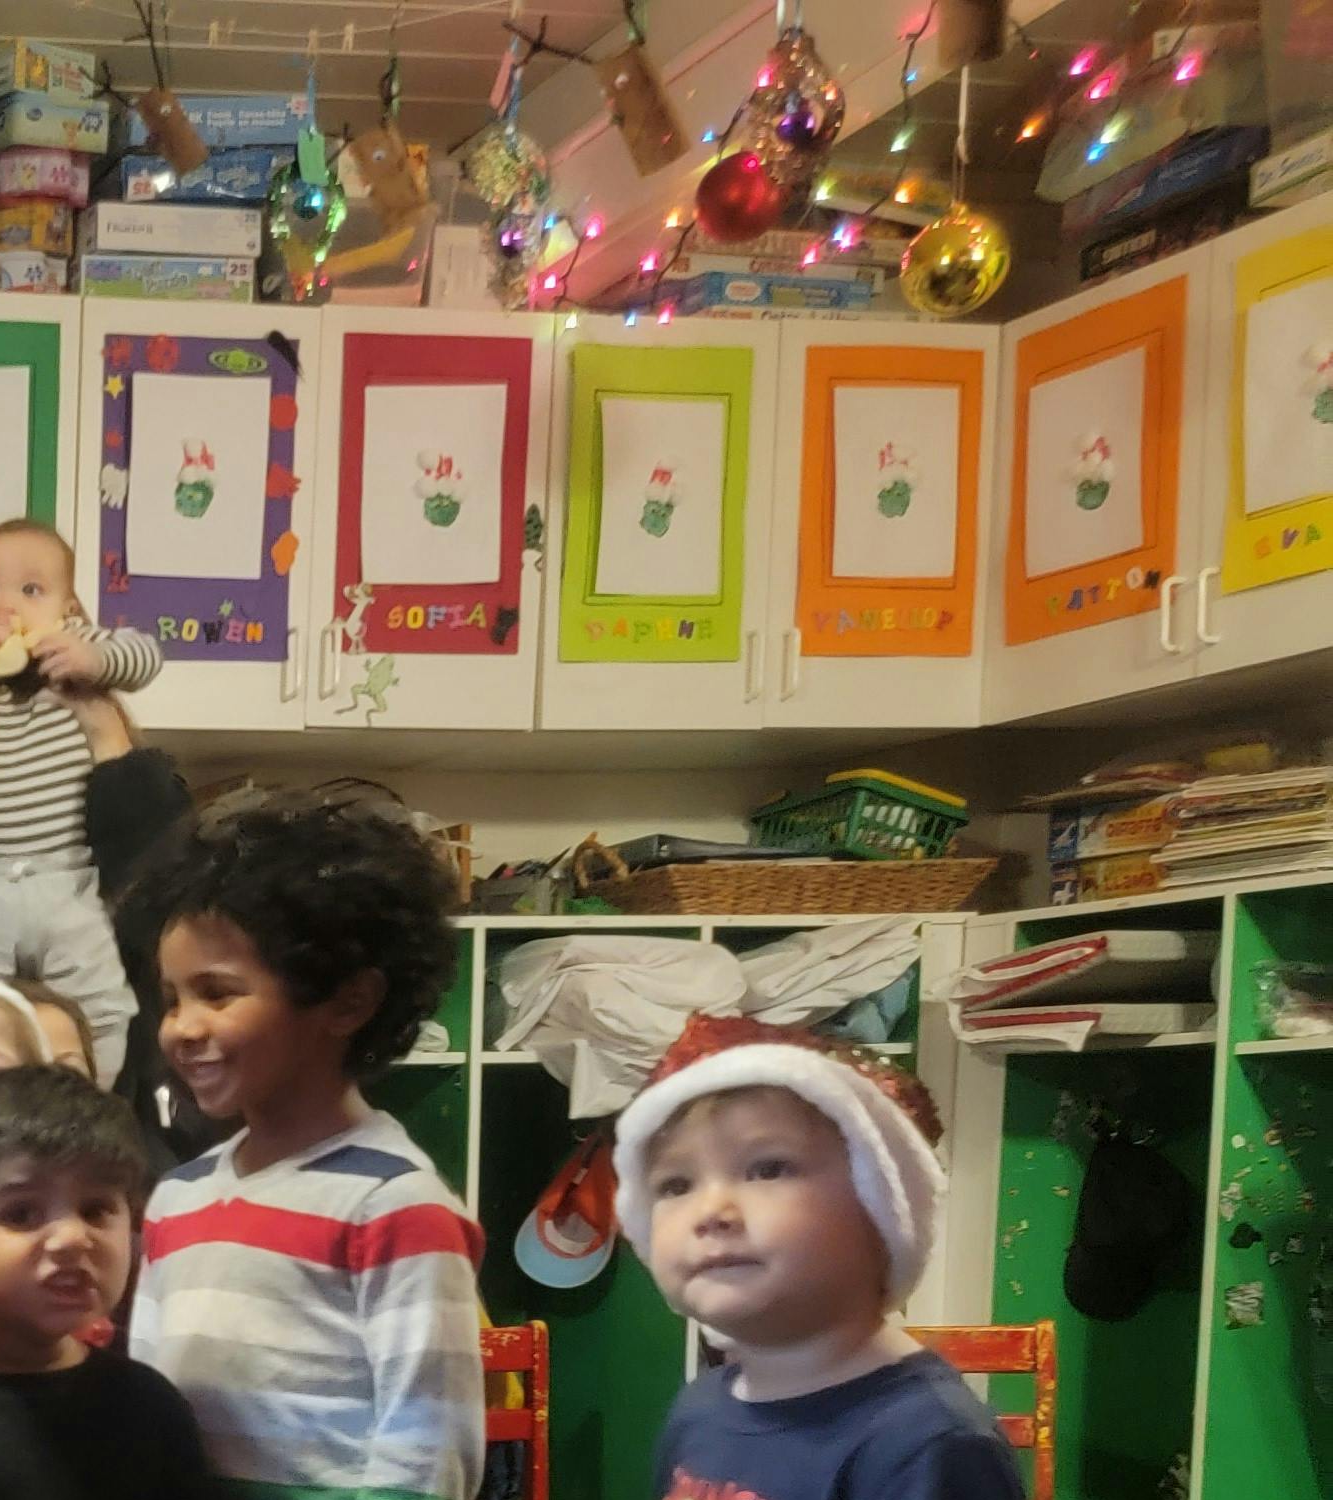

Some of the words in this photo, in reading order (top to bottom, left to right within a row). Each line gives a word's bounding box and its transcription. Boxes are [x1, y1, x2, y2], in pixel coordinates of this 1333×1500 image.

[229, 264, 248, 277] 25
[387, 602, 487, 630] SOFIA
[583, 616, 713, 644] DAPHNE
